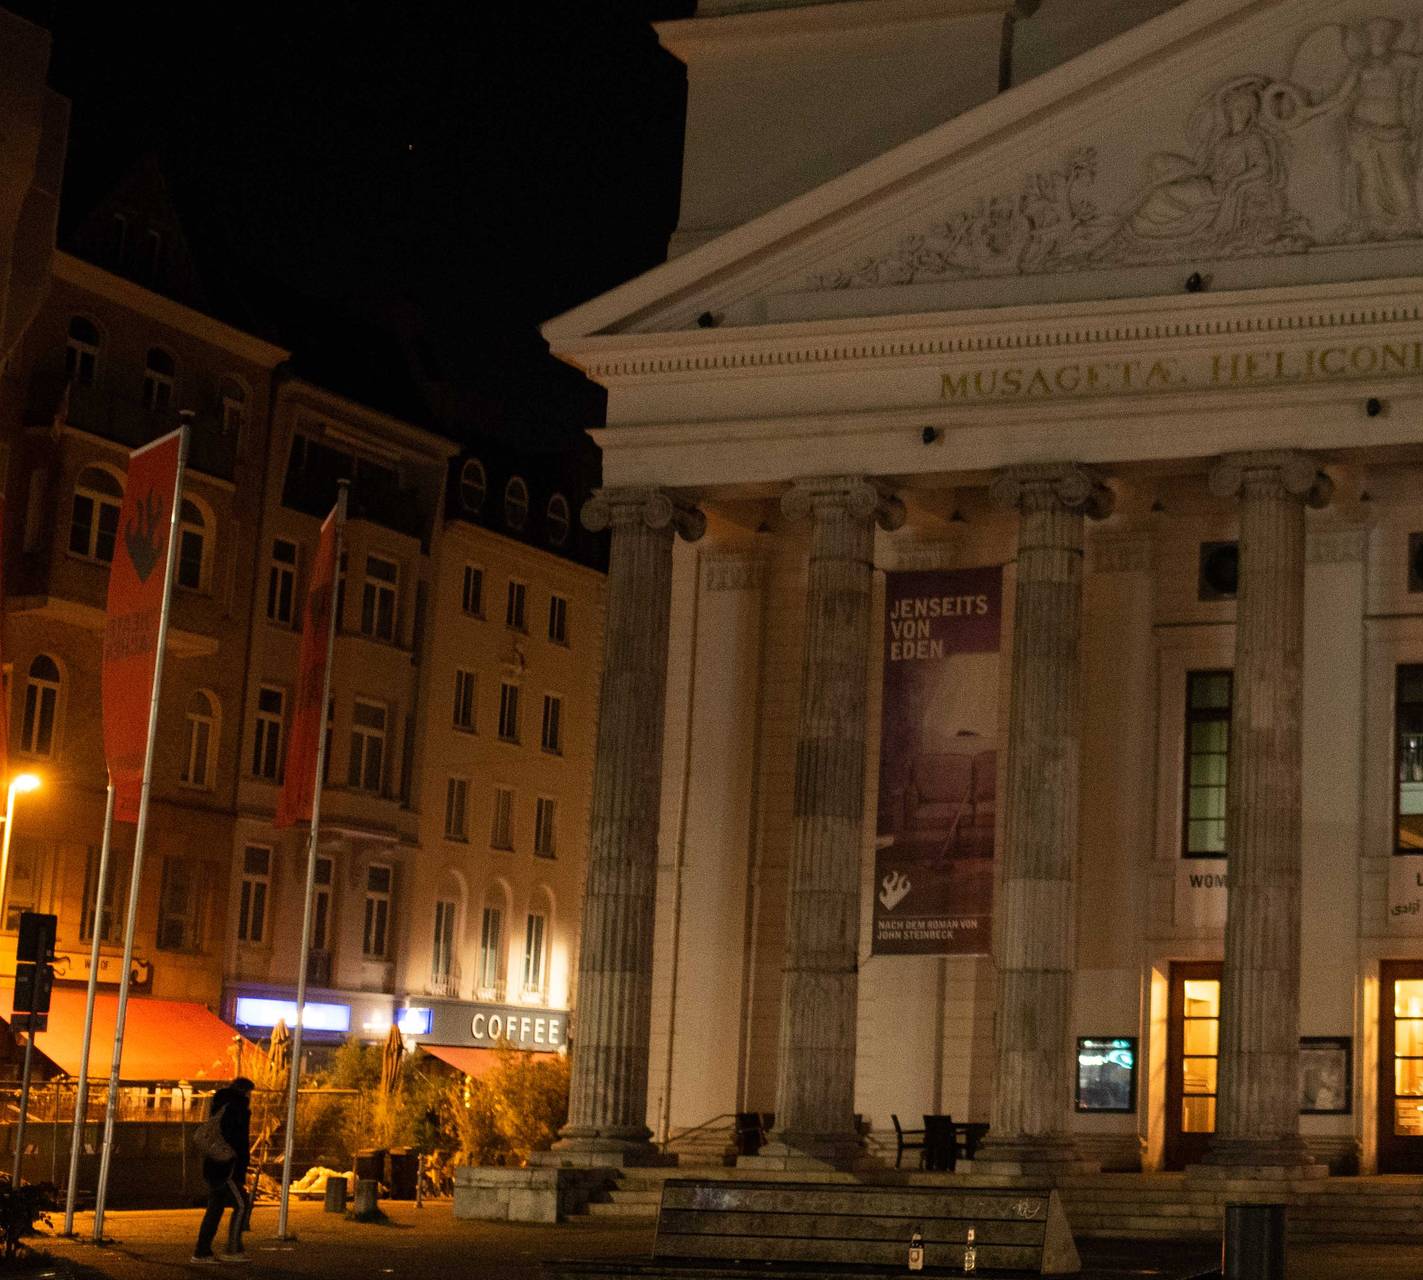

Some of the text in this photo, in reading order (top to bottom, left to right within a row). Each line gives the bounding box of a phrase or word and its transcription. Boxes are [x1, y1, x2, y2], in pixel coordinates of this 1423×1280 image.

[890, 595, 989, 619] JENSEITS
[891, 619, 930, 640] VON
[890, 640, 943, 661] EDEN
[1189, 874, 1227, 889] WOM
[878, 930, 954, 940] JOHN STEINBECK
[879, 920, 904, 930] NACH
[960, 919, 978, 929] VON
[471, 1012, 560, 1045] COFFEE
